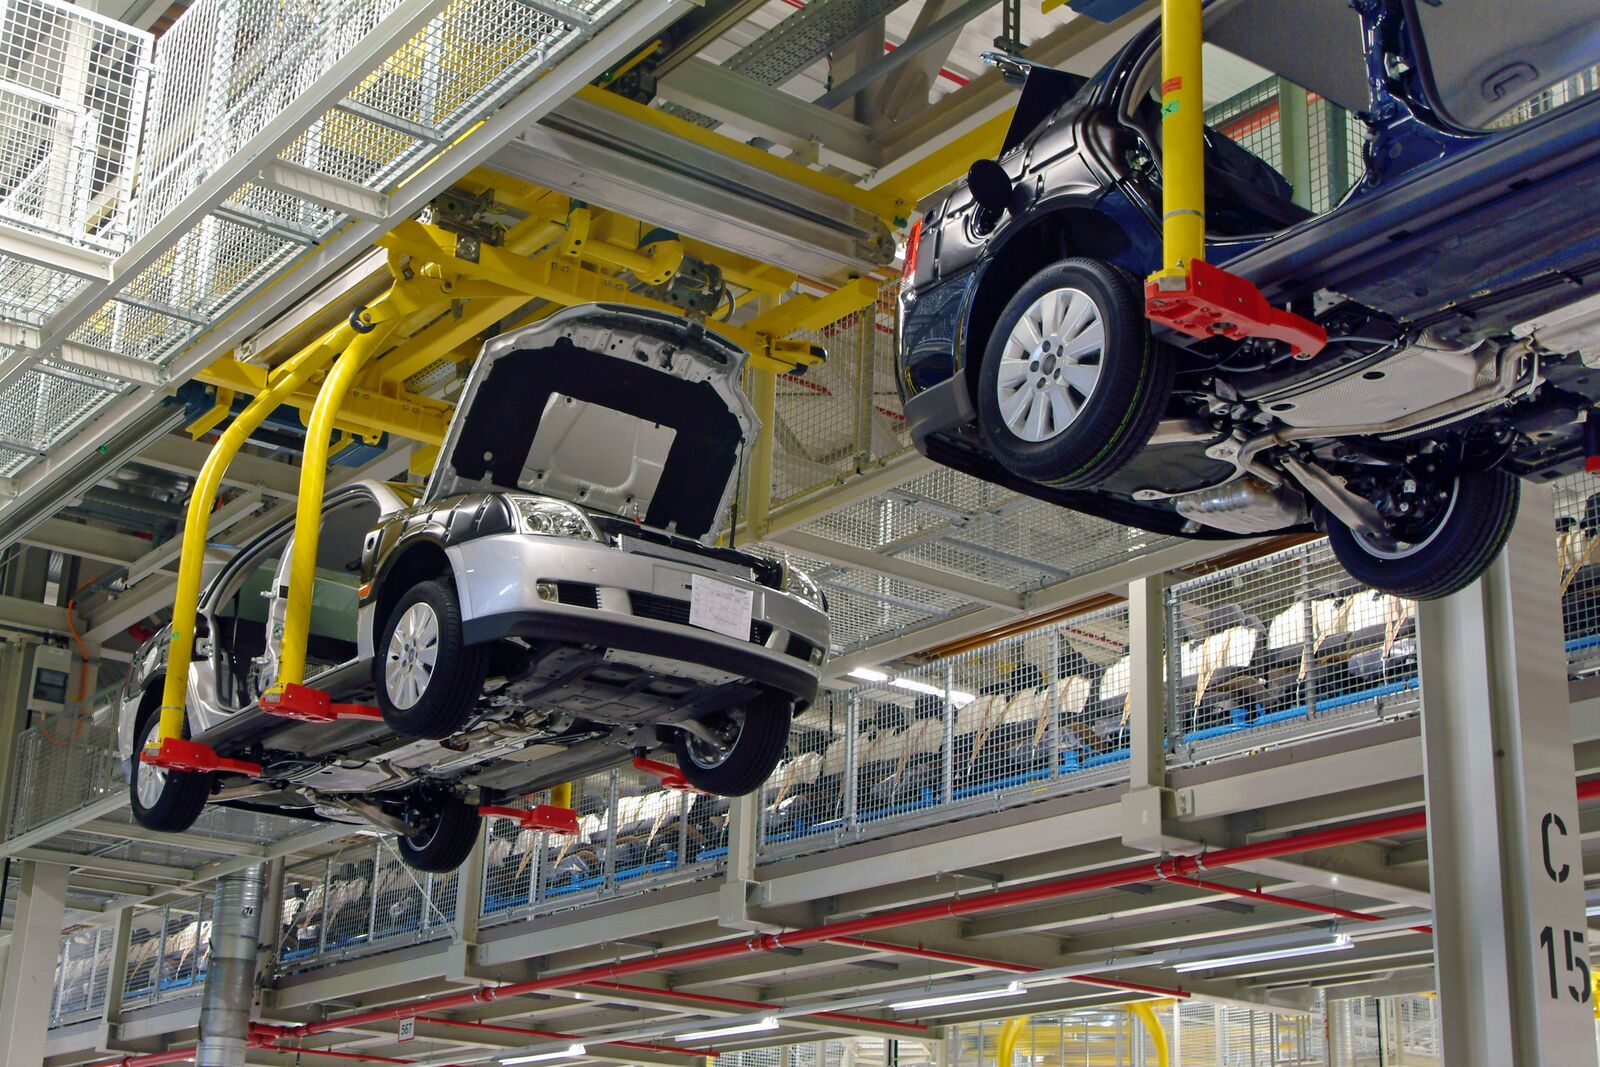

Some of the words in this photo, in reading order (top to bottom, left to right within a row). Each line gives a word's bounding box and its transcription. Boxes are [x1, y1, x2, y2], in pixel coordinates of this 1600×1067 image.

[1541, 812, 1570, 883] C
[1540, 926, 1591, 1003] 15
[401, 1022, 413, 1036] 567
